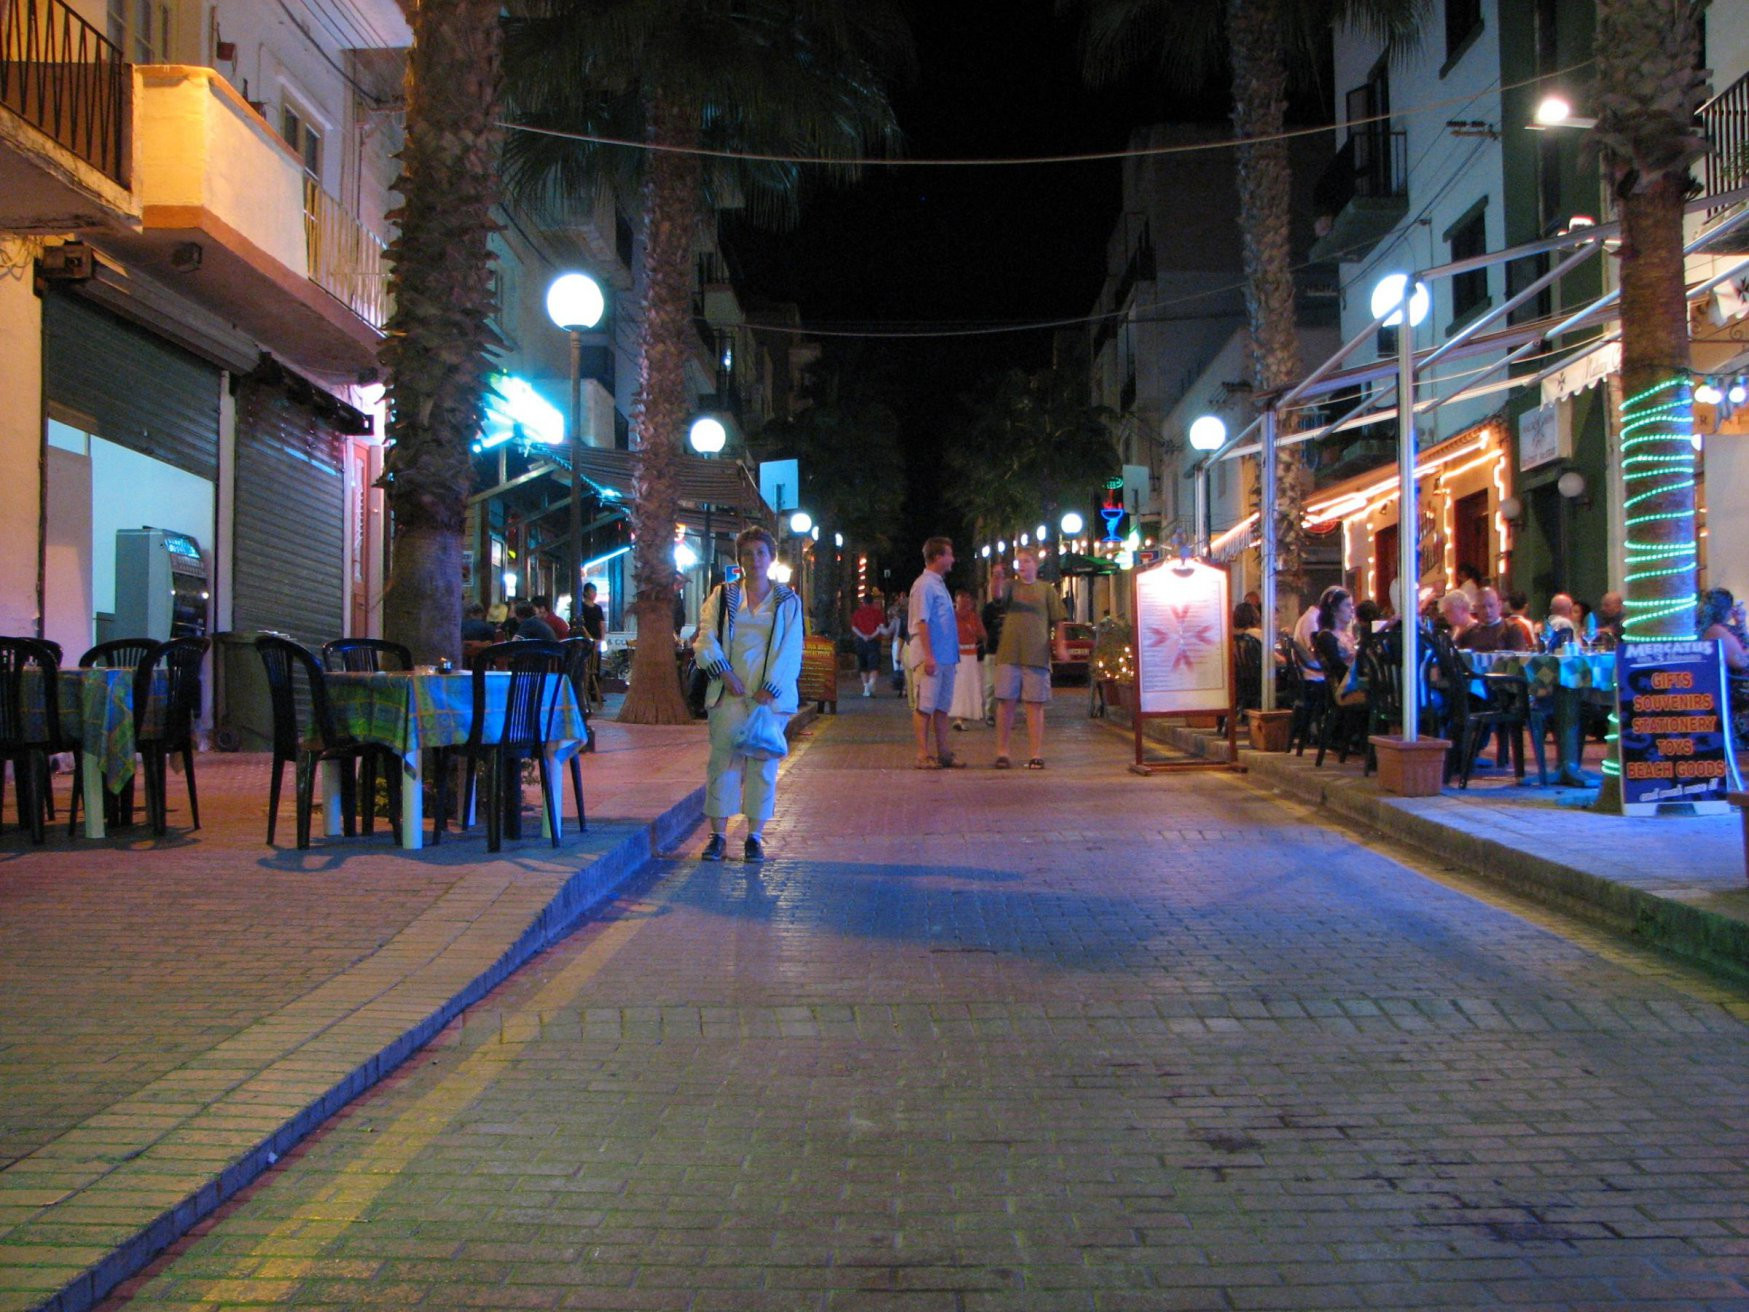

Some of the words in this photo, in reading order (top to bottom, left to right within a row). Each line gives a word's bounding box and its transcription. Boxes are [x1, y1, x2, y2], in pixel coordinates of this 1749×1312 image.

[1624, 641, 1713, 659] MERCATUS
[1651, 672, 1693, 689] GIFTS
[1633, 693, 1713, 711] SOUVENIRS
[1632, 716, 1717, 734] STATIONERY
[1656, 738, 1694, 755] TOYS
[1626, 761, 1673, 779] BEACH
[1675, 760, 1725, 777] GOODS
